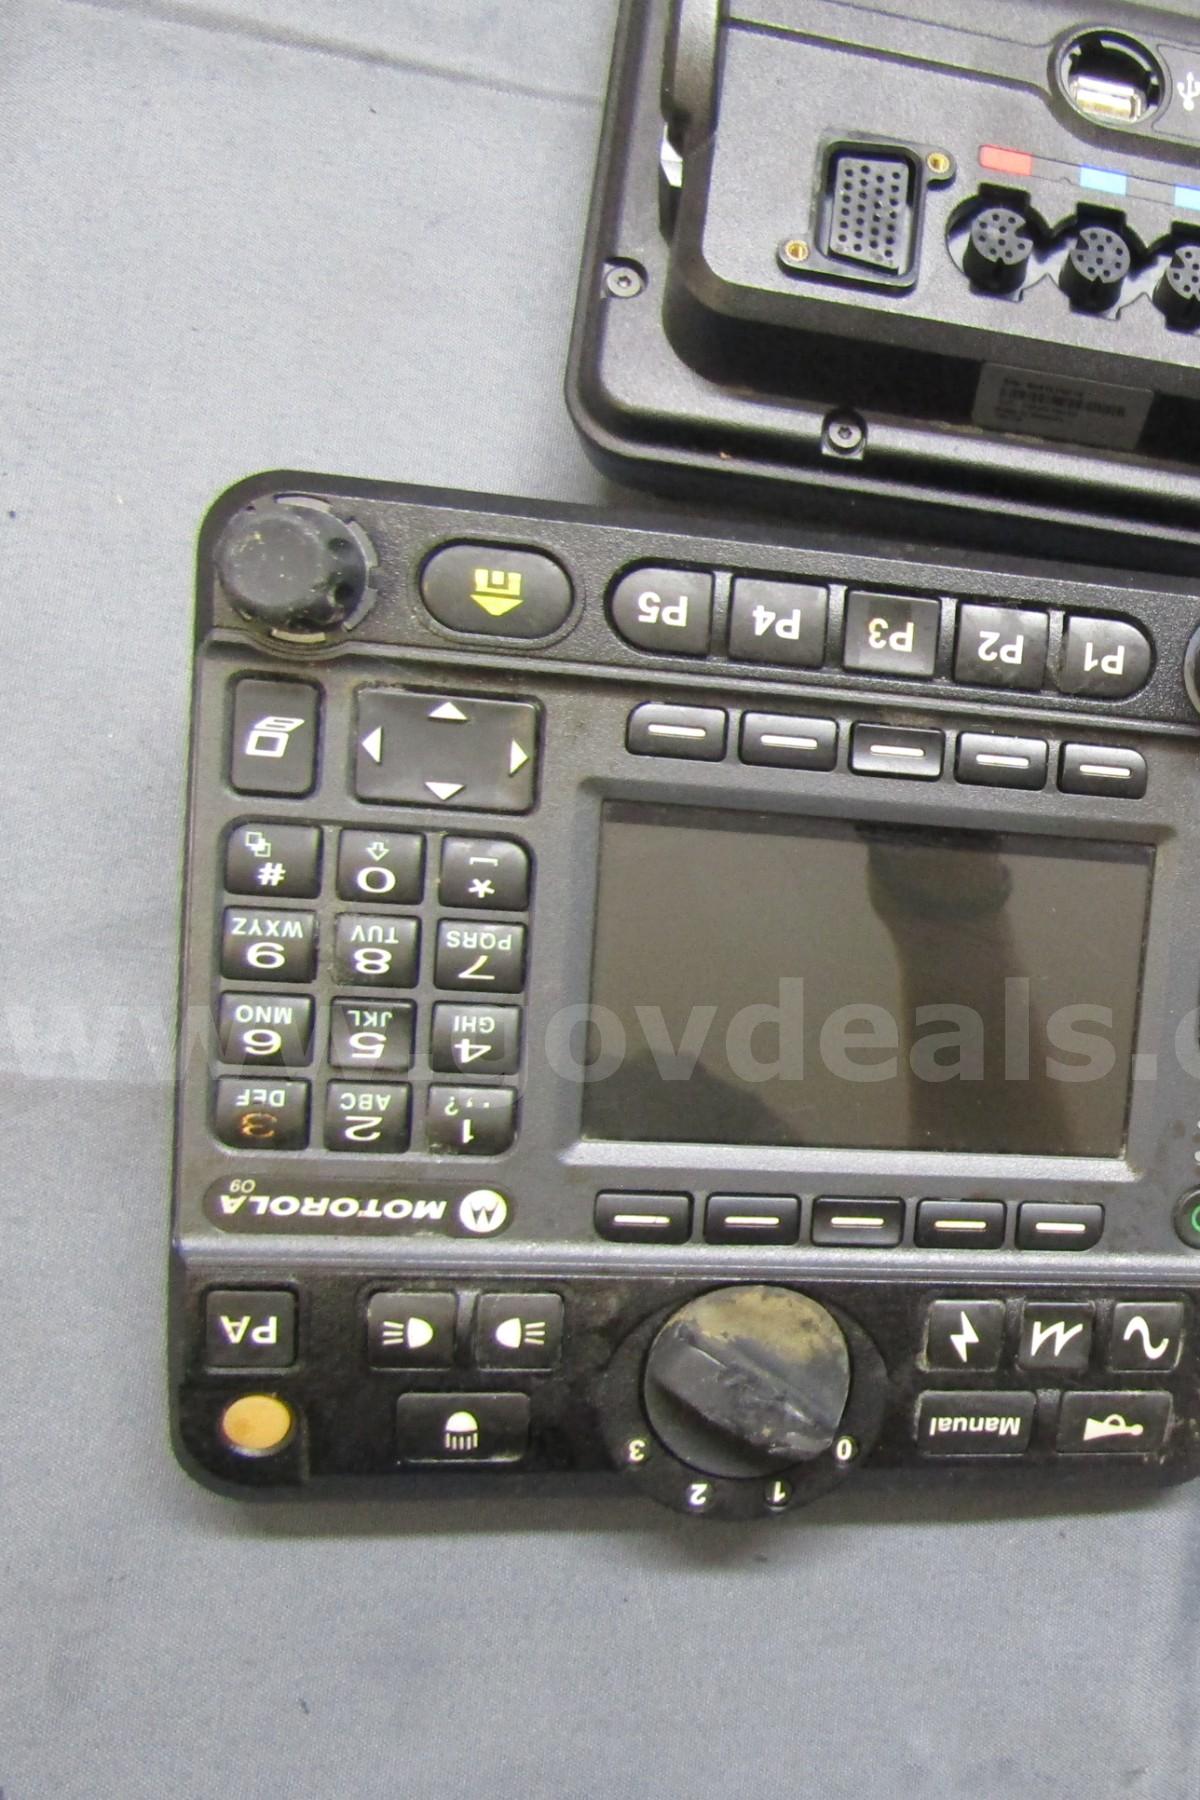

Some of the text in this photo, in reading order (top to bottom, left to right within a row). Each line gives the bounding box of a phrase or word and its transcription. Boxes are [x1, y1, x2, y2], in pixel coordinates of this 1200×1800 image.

[637, 591, 688, 628] P5
[751, 608, 802, 641] P4
[867, 616, 916, 654] P3
[977, 630, 1026, 666] P2
[1083, 641, 1126, 676] P1
[230, 916, 303, 939] WXYZ
[350, 924, 399, 944] TUV
[445, 930, 513, 952] PQRS
[245, 941, 285, 969] 9
[353, 947, 392, 974] 8
[458, 954, 495, 980] 7
[234, 1004, 293, 1025] MNO
[347, 1010, 393, 1028] JKL
[453, 1015, 496, 1034] GHI
[240, 1028, 282, 1055] 6
[348, 1031, 387, 1060] 5
[453, 1037, 492, 1064] 4
[235, 1088, 286, 1107] DEF
[340, 1092, 392, 1111] ABC
[240, 1111, 278, 1137] 3
[344, 1115, 383, 1142] 2
[462, 1118, 474, 1144] 1
[220, 1194, 447, 1220] MOTOROLA
[220, 1315, 278, 1345] PA
[929, 1416, 1021, 1436] Manual
[628, 1438, 646, 1462] 3
[836, 1438, 853, 1461] 0
[689, 1483, 708, 1507] 2
[772, 1481, 786, 1503] 1
